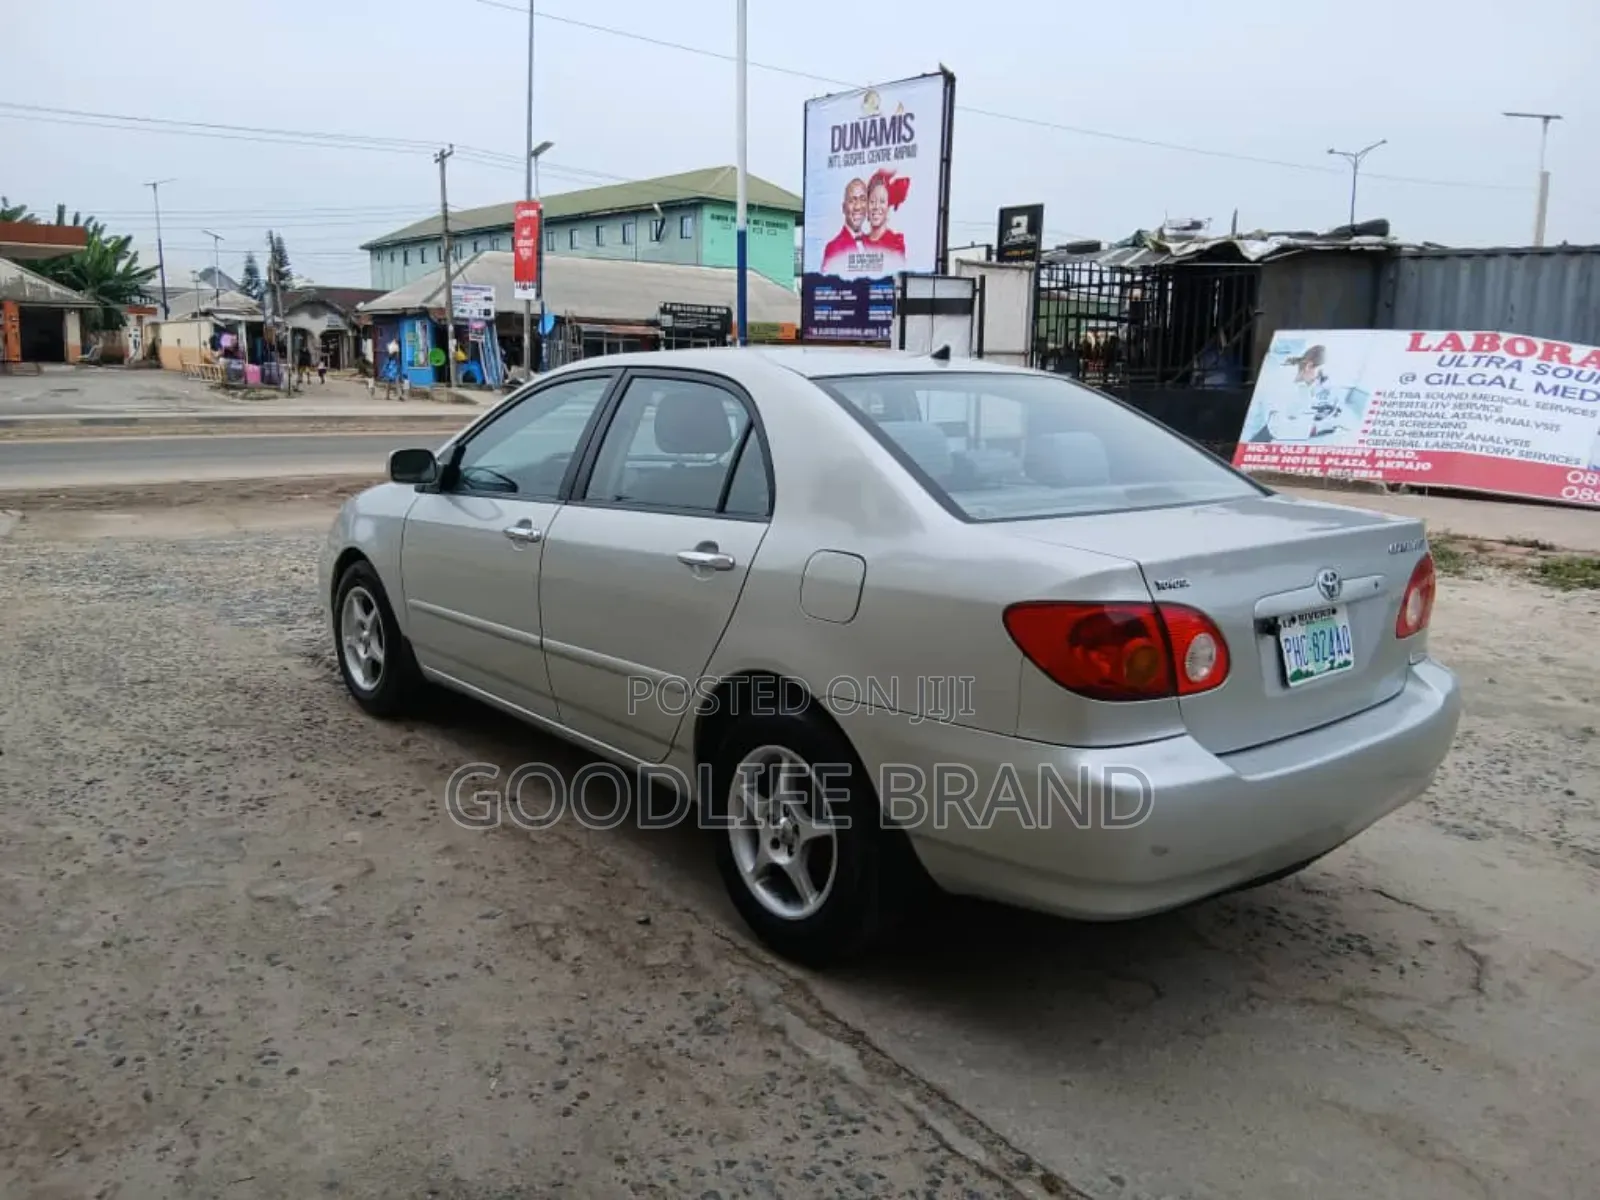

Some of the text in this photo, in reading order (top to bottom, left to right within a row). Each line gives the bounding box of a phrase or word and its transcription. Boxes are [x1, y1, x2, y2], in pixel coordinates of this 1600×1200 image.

[831, 112, 915, 153] DUNAMIS
[867, 147, 891, 163] CENTRE
[1437, 354, 1600, 386] ULTRA SOU
[1400, 372, 1417, 385] @
[1425, 372, 1524, 392] GILGAL
[1382, 391, 1598, 418] ULTRA SOUND MEDICAL SERVICES
[1376, 410, 1448, 420] HORMONAL
[1494, 416, 1561, 432] ANALYSIS
[1399, 420, 1467, 430] SCREENING
[1369, 429, 1392, 437] ALL
[1464, 432, 1531, 448] ANALYSIS
[1279, 445, 1307, 455] OLD
[1366, 439, 1581, 465] GENERAL LABORATORY SERVICES
[1280, 455, 1321, 466] HOTEL
[1375, 460, 1432, 472] AKPAJO
